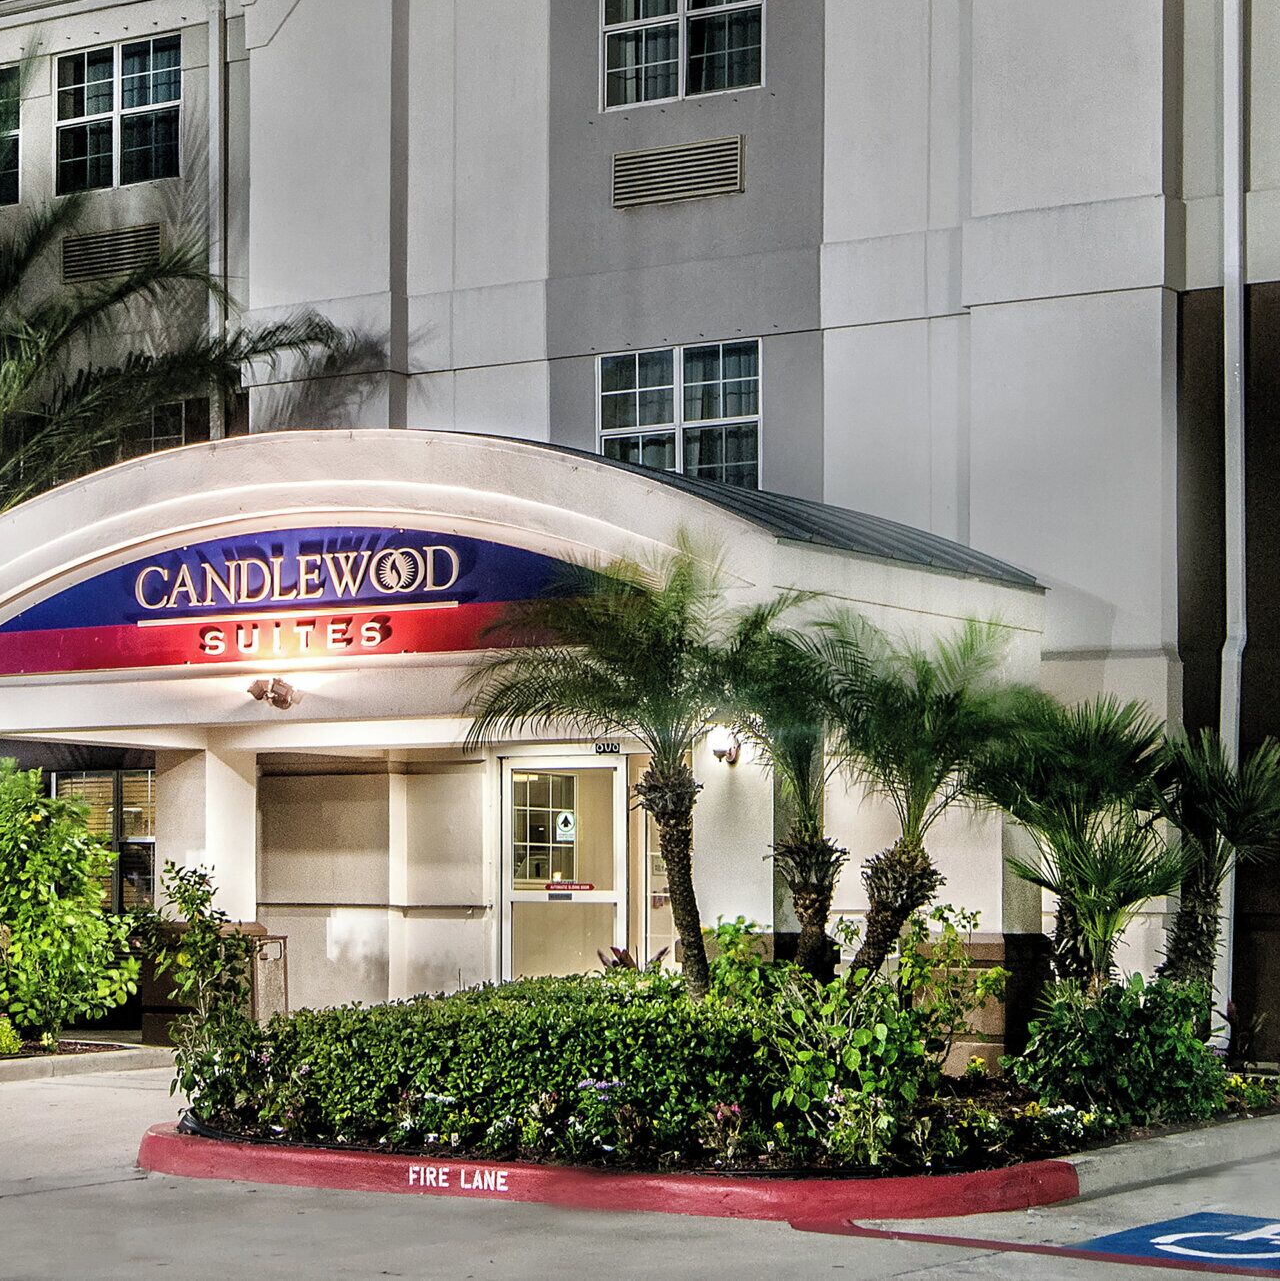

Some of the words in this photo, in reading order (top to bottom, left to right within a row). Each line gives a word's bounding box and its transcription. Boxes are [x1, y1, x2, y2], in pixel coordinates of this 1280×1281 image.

[136, 545, 459, 610] CANDLEWOOD
[203, 621, 384, 656] SUITES
[408, 1165, 450, 1188] FIRE
[460, 1168, 509, 1192] LANE
